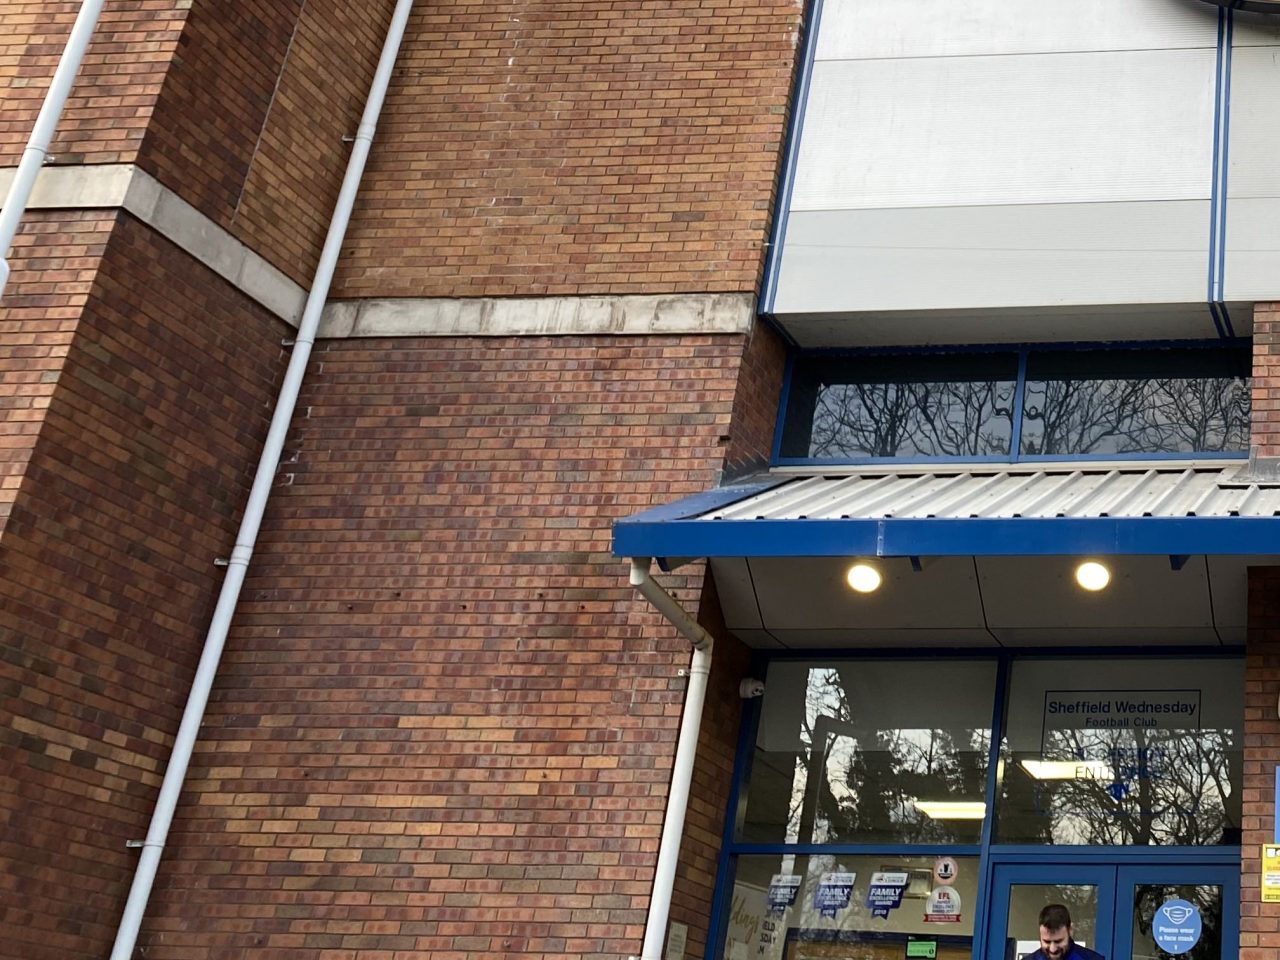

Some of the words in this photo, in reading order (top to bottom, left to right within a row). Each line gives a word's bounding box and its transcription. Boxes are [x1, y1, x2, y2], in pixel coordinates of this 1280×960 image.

[1048, 701, 1111, 714] Sheffield
[1115, 701, 1197, 716] Wednesday
[1085, 717, 1129, 727] Football
[1133, 717, 1158, 727] Club
[870, 888, 902, 896] FAMILY
